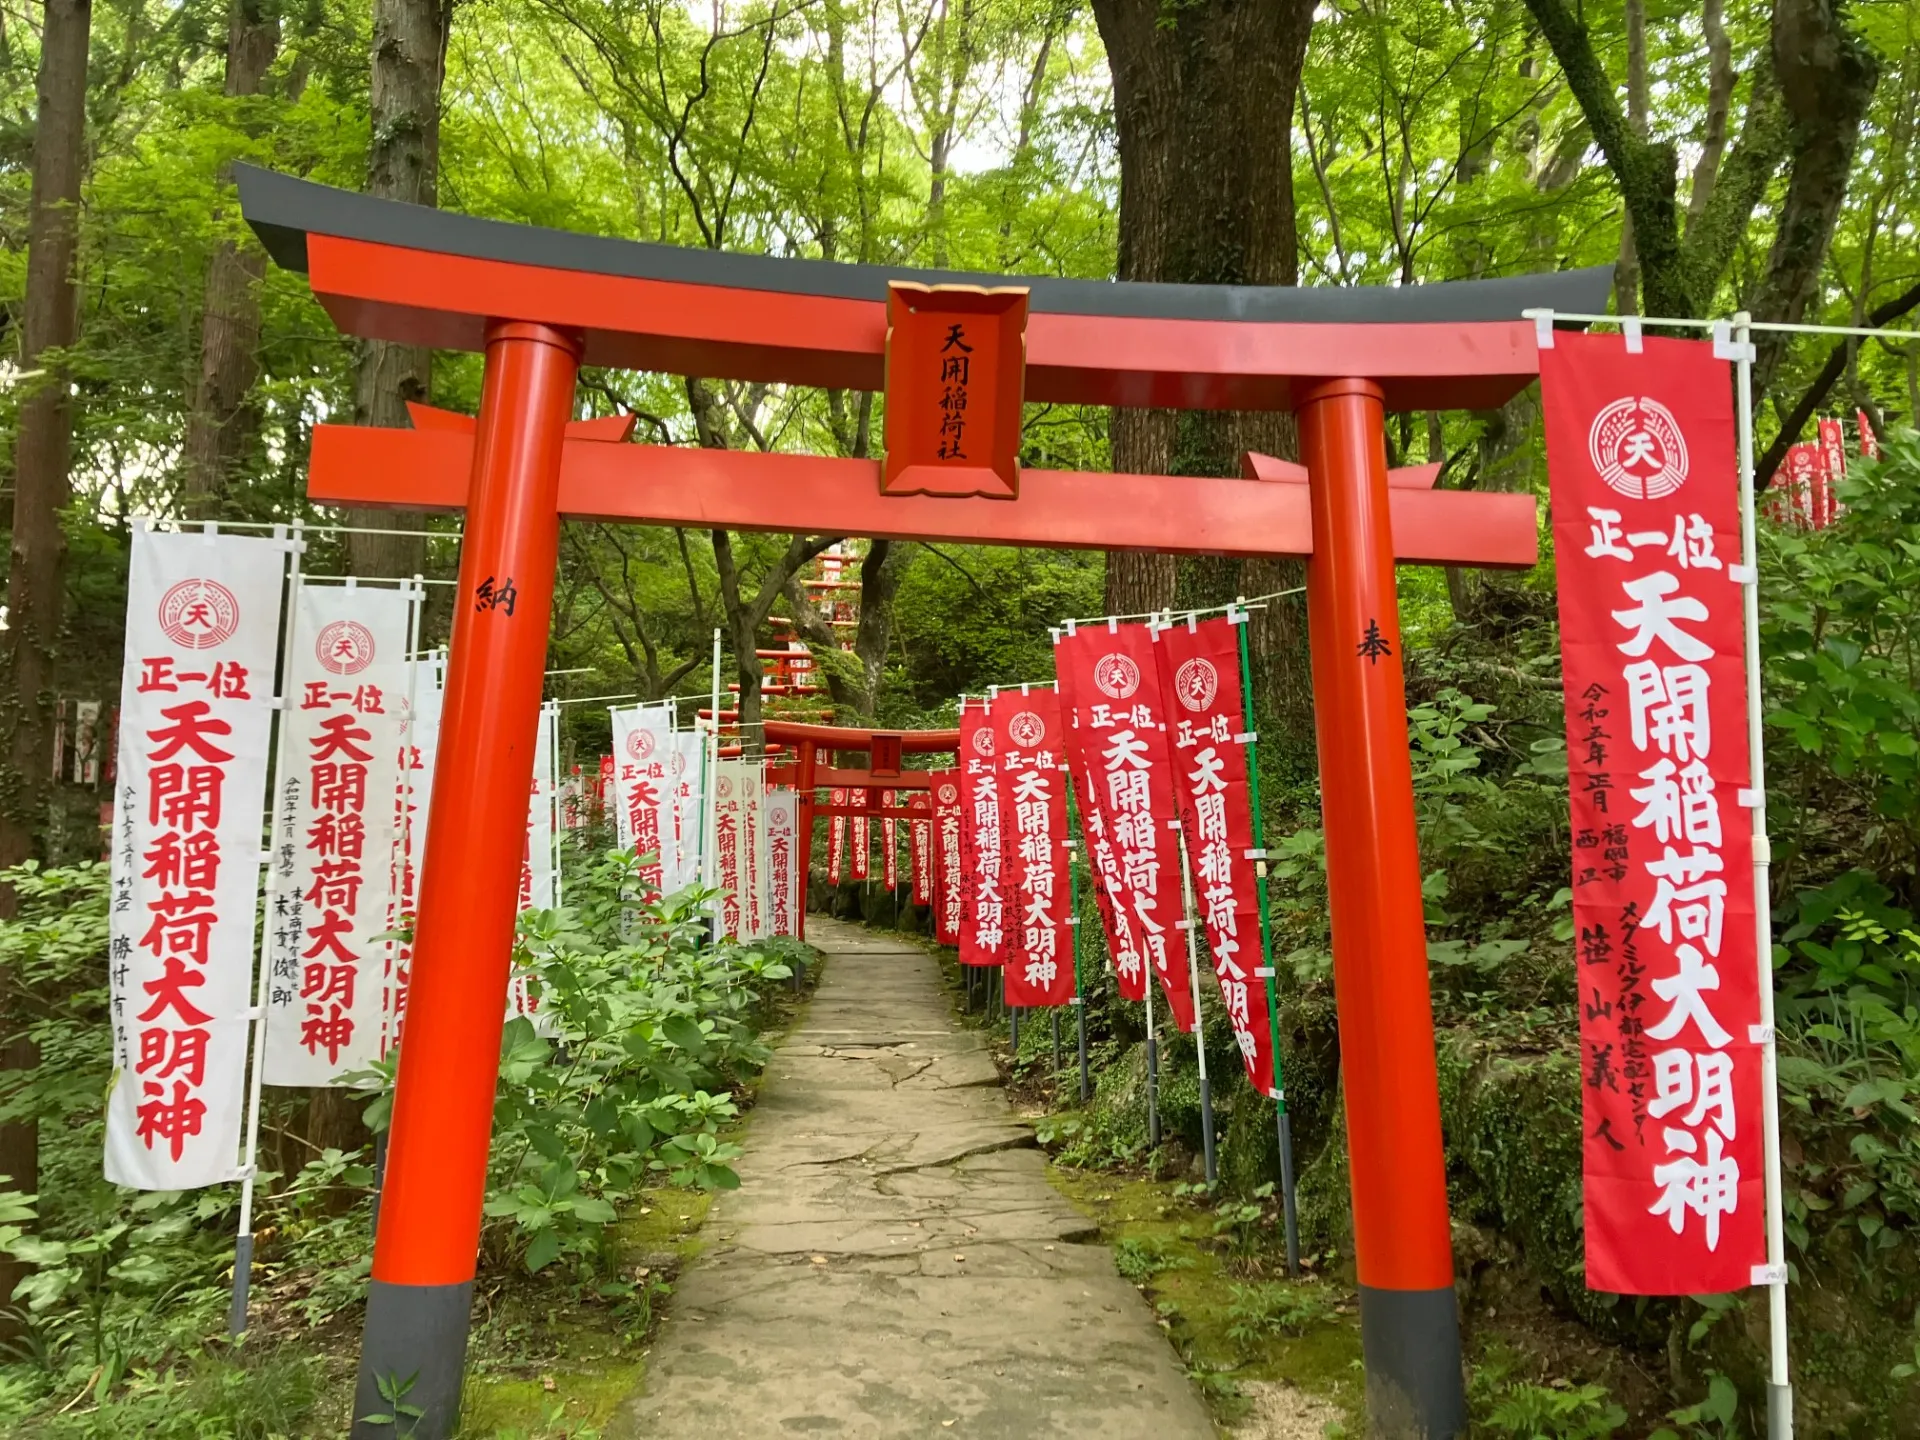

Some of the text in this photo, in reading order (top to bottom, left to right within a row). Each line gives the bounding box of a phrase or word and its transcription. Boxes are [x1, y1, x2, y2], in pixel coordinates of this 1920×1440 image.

[938, 324, 974, 460] 天開稲荷社
[1584, 506, 1724, 571] 正一位
[475, 575, 517, 617] 納
[1356, 618, 1392, 666] 奉
[137, 657, 251, 700] 正一位
[300, 682, 385, 714] 正一位
[1091, 703, 1156, 729] 正一位
[1176, 715, 1232, 748] 正一位
[622, 762, 665, 781] 正一位
[1004, 750, 1056, 770] 正一位
[768, 827, 791, 837] 正一位
[937, 805, 961, 816] 正一位
[941, 817, 961, 937] 天開稲荷大明神
[972, 776, 1004, 954] 天開稲荷大明神
[1012, 770, 1058, 992] 天開稲荷大明神
[300, 714, 376, 1065] 天開稲荷大明神
[1187, 747, 1258, 1074] 天開稲荷大明神
[1610, 571, 1739, 1253] 天開稲荷大明神
[135, 700, 235, 1163] 天開稲荷大明神
